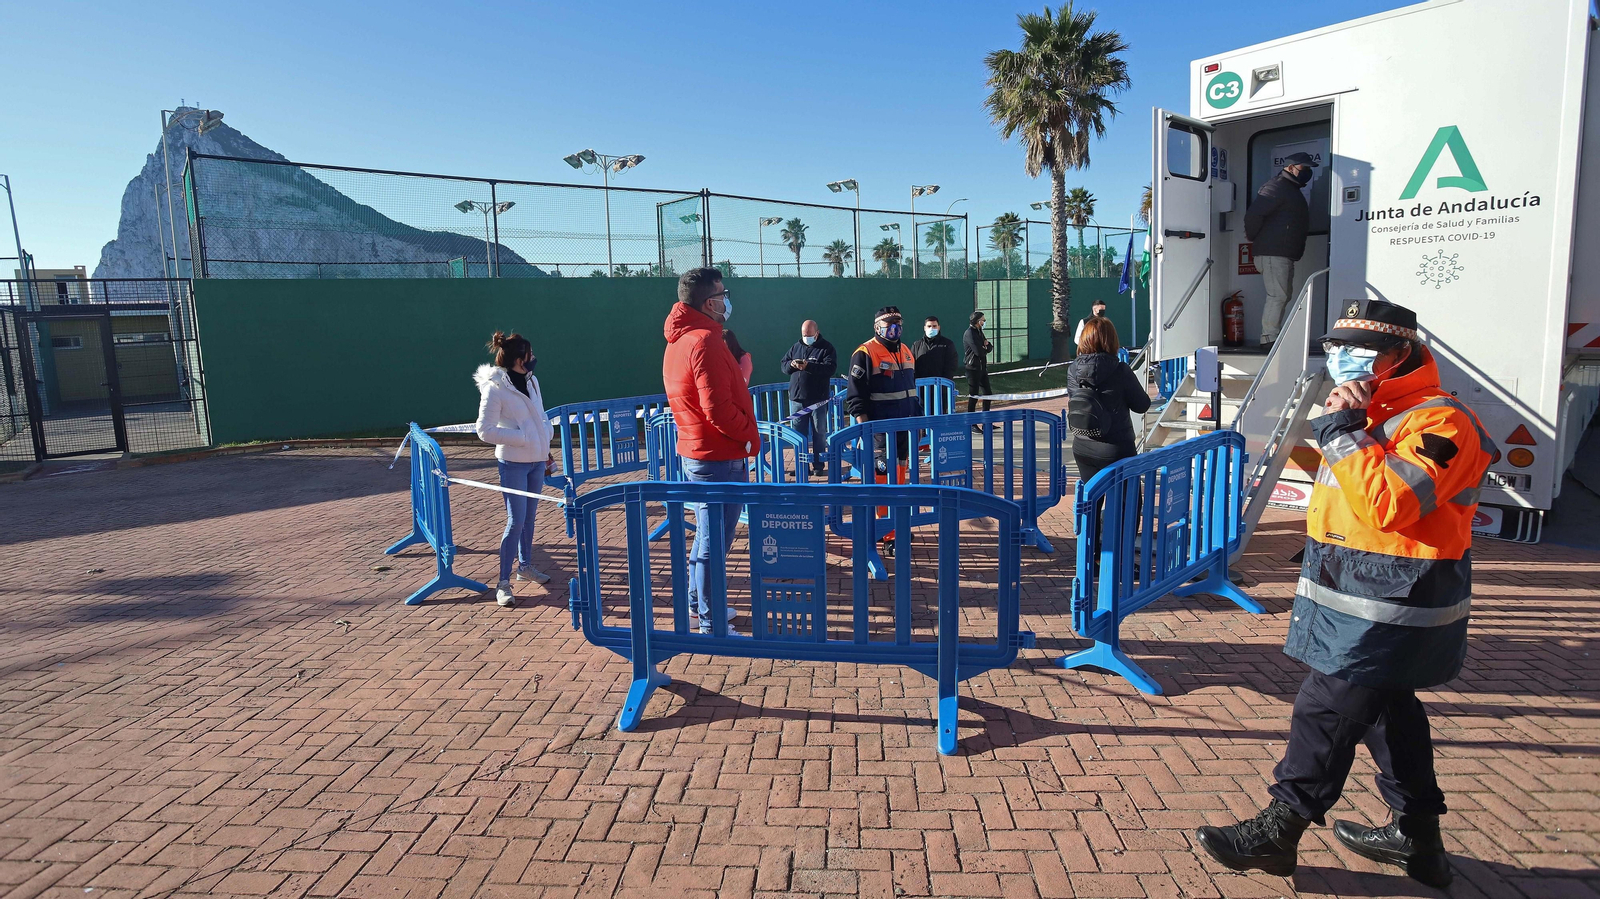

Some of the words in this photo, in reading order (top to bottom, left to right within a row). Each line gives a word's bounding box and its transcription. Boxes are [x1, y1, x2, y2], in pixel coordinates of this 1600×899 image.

[1209, 80, 1240, 100] C3
[1274, 153, 1321, 165] ENDA
[1355, 207, 1405, 222] Junta
[1410, 203, 1433, 217] de
[1437, 191, 1541, 215] Andalucía
[1371, 221, 1419, 234] Consejería
[1421, 221, 1434, 230] de
[1436, 218, 1465, 229] Salud
[1466, 218, 1473, 228] y
[1475, 215, 1520, 226] Familias
[1390, 234, 1446, 246] RESPUESTA
[1447, 231, 1496, 242] COVID-19
[1488, 474, 1516, 487] HGW
[761, 520, 813, 530] DEPORTES
